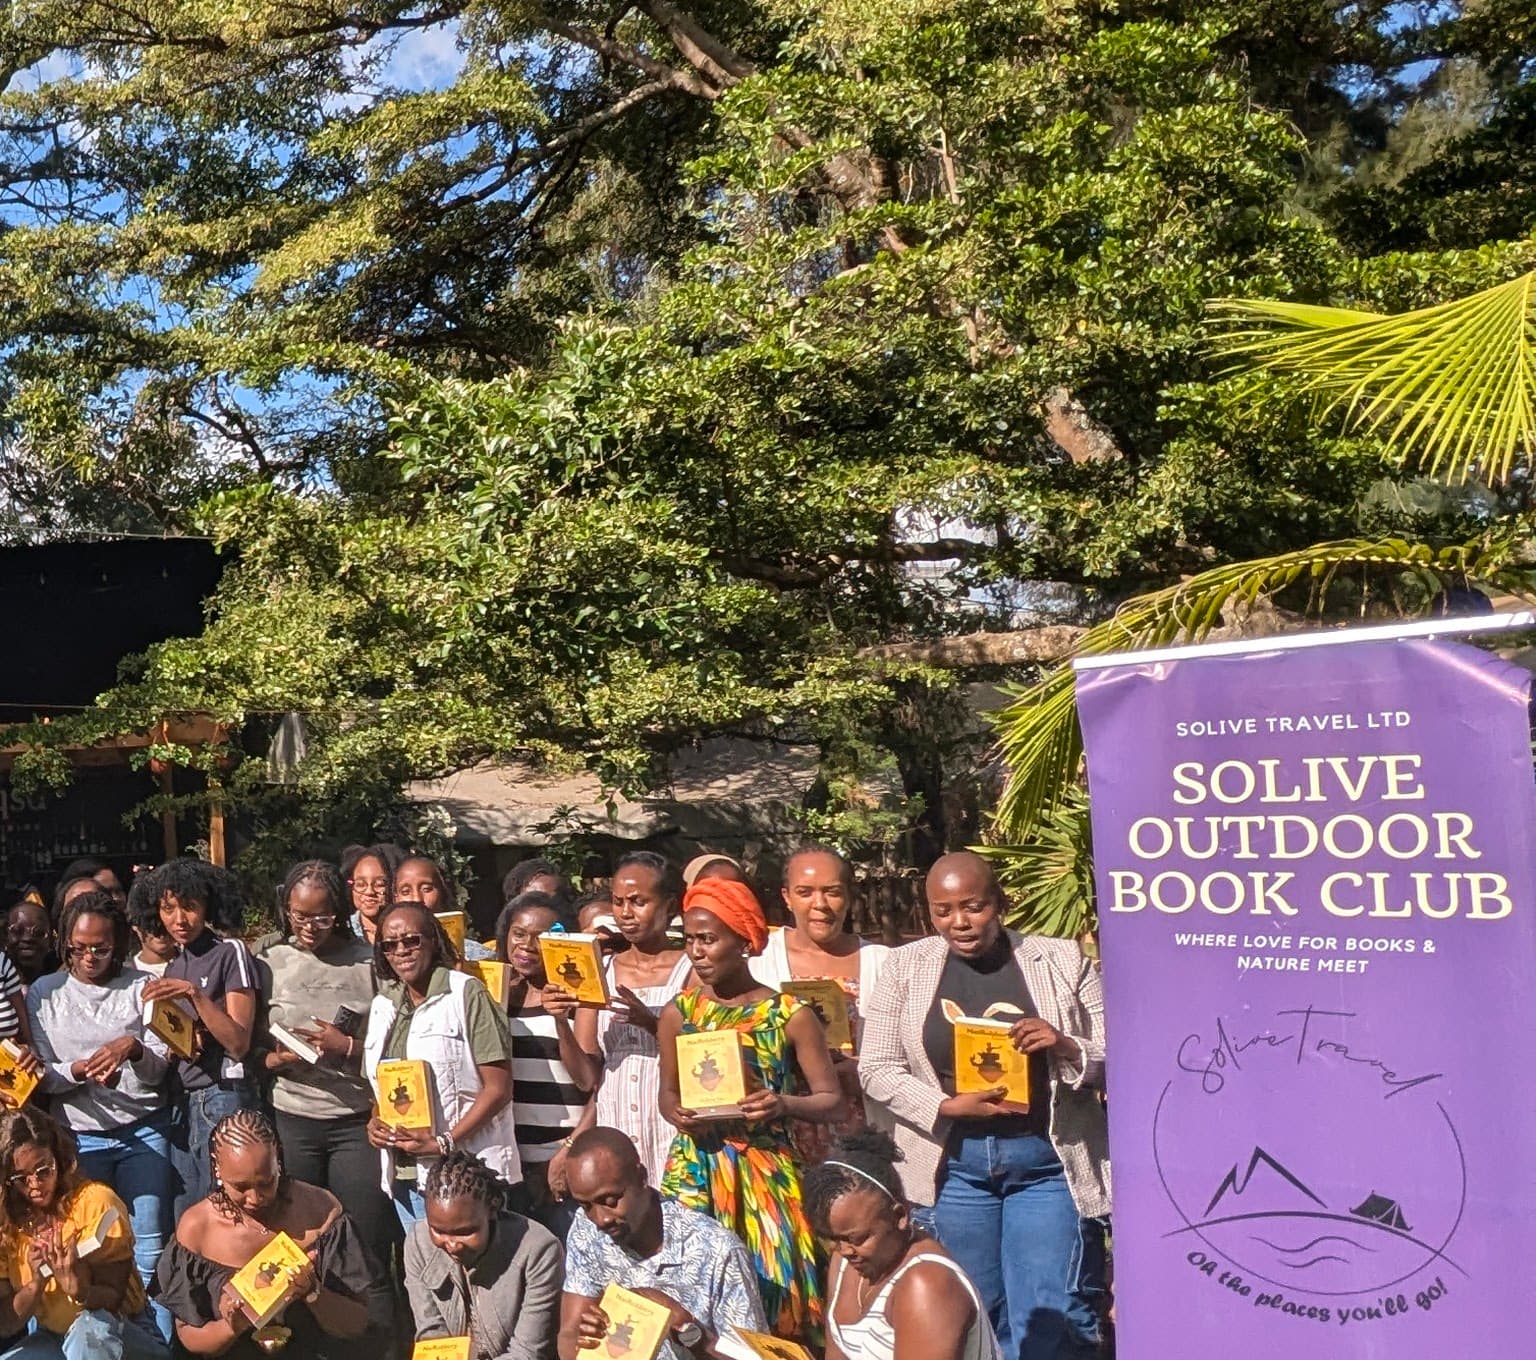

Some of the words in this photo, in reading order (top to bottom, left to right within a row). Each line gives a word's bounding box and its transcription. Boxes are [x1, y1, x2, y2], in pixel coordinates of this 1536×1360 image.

[1176, 718, 1257, 737] SOLIVE
[1265, 714, 1359, 732] TRAVEL
[1367, 711, 1411, 728] LTD
[1172, 754, 1425, 805] SOLIVE
[1128, 812, 1482, 859] OUTDOOR
[1108, 871, 1299, 916] BOOK
[1320, 871, 1513, 920] CLUB
[1174, 933, 1237, 947] WHERE
[1243, 935, 1292, 949] LOVE
[1298, 936, 1337, 950] FOR
[1345, 937, 1416, 953] BOOKS
[1422, 939, 1436, 953] &
[1237, 956, 1311, 971] NATURE
[1317, 958, 1369, 973] MEET
[1186, 1251, 1218, 1276] Oh
[1218, 1271, 1252, 1296] the
[1254, 1292, 1331, 1322] places
[1337, 1293, 1409, 1325] you'll
[1415, 1277, 1449, 1310] go!
